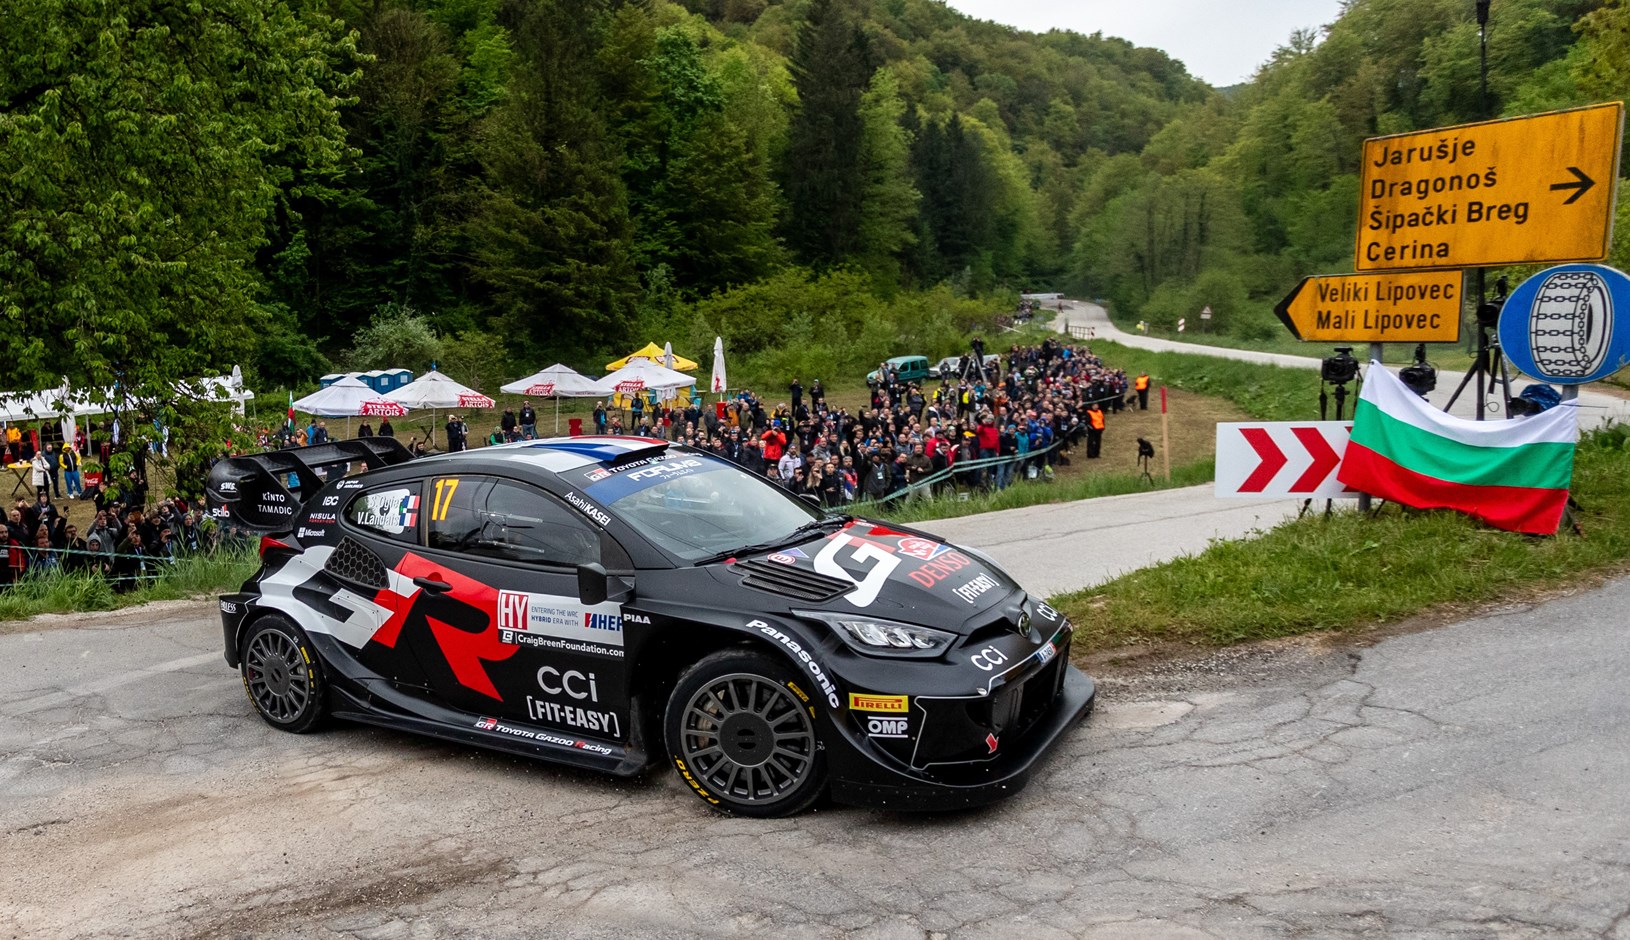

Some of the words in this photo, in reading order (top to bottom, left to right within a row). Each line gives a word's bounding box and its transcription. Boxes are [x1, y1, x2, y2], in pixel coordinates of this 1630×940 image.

[1373, 137, 1476, 168] Jarušje
[1371, 166, 1497, 200] Dragonoš
[1369, 203, 1457, 234] Šipački
[1466, 201, 1529, 225] Breg
[1366, 240, 1450, 262] Cerina
[1318, 282, 1369, 303] Veliki
[1375, 281, 1454, 306] Lipovec
[1316, 309, 1355, 330] Mali
[1363, 309, 1440, 334] Lipovec
[463, 400, 489, 408] ARTOIS
[367, 408, 400, 416] ARTOIS
[609, 459, 647, 473] TOYOTA
[431, 478, 460, 521] 17
[212, 504, 230, 518] Stilo
[257, 504, 293, 516] TAMADIC
[309, 513, 336, 521] NISULA
[304, 529, 325, 537] Microsoft
[907, 551, 971, 589] DENSO
[500, 593, 528, 630] HY
[531, 606, 556, 615] ENTERING
[531, 615, 552, 623] HYBRID
[552, 617, 564, 625] ERA
[564, 619, 579, 627] WITH
[623, 613, 651, 625] PIAA
[745, 619, 840, 709] Panasonic
[853, 696, 903, 709] PIRELLI
[867, 720, 908, 734] OMP
[495, 724, 534, 739] TOYOTA
[535, 733, 575, 747] GAZOO
[575, 740, 612, 755] Racing
